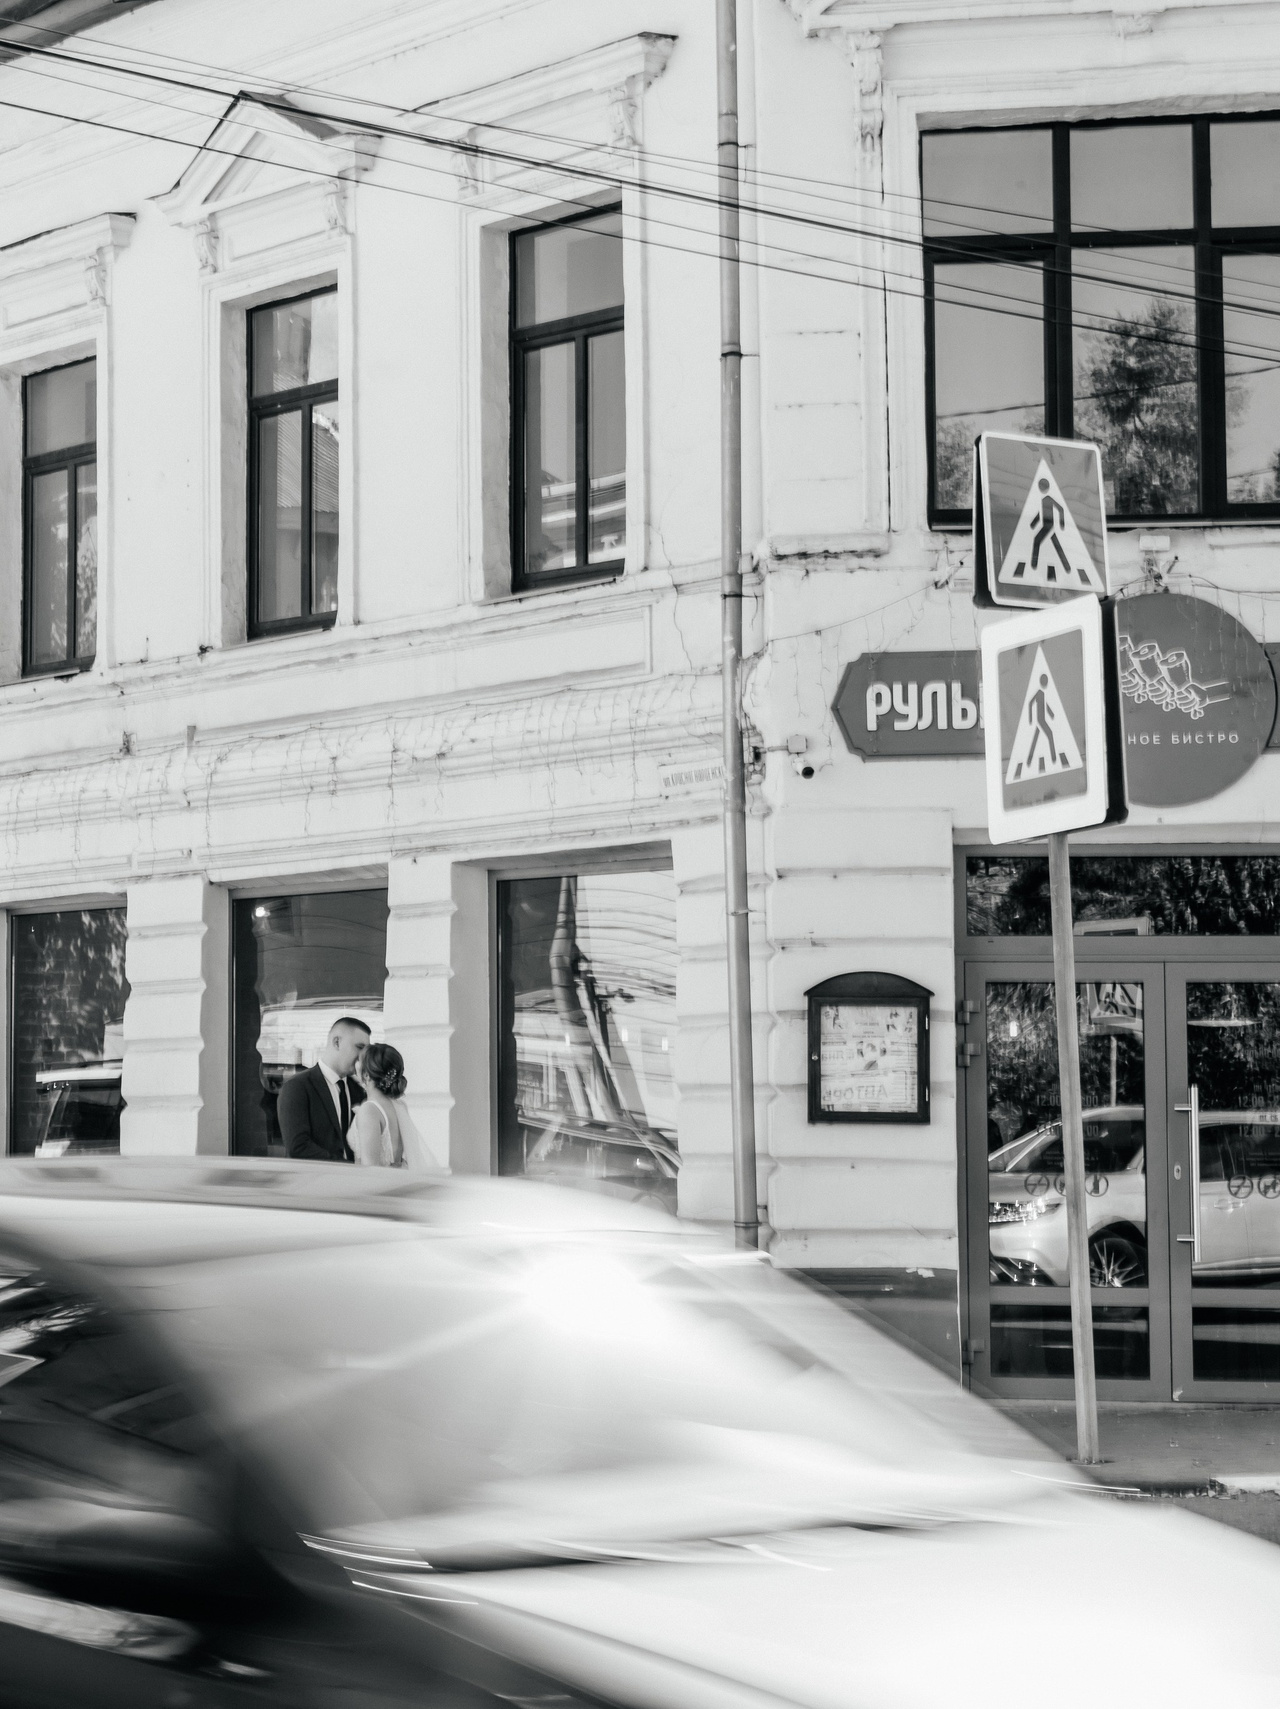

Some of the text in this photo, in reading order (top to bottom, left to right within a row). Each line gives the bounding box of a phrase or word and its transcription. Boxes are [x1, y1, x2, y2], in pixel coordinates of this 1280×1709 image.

[866, 680, 984, 731] РУЛЬ
[1127, 730, 1239, 745] НОЕ БИСТРО
